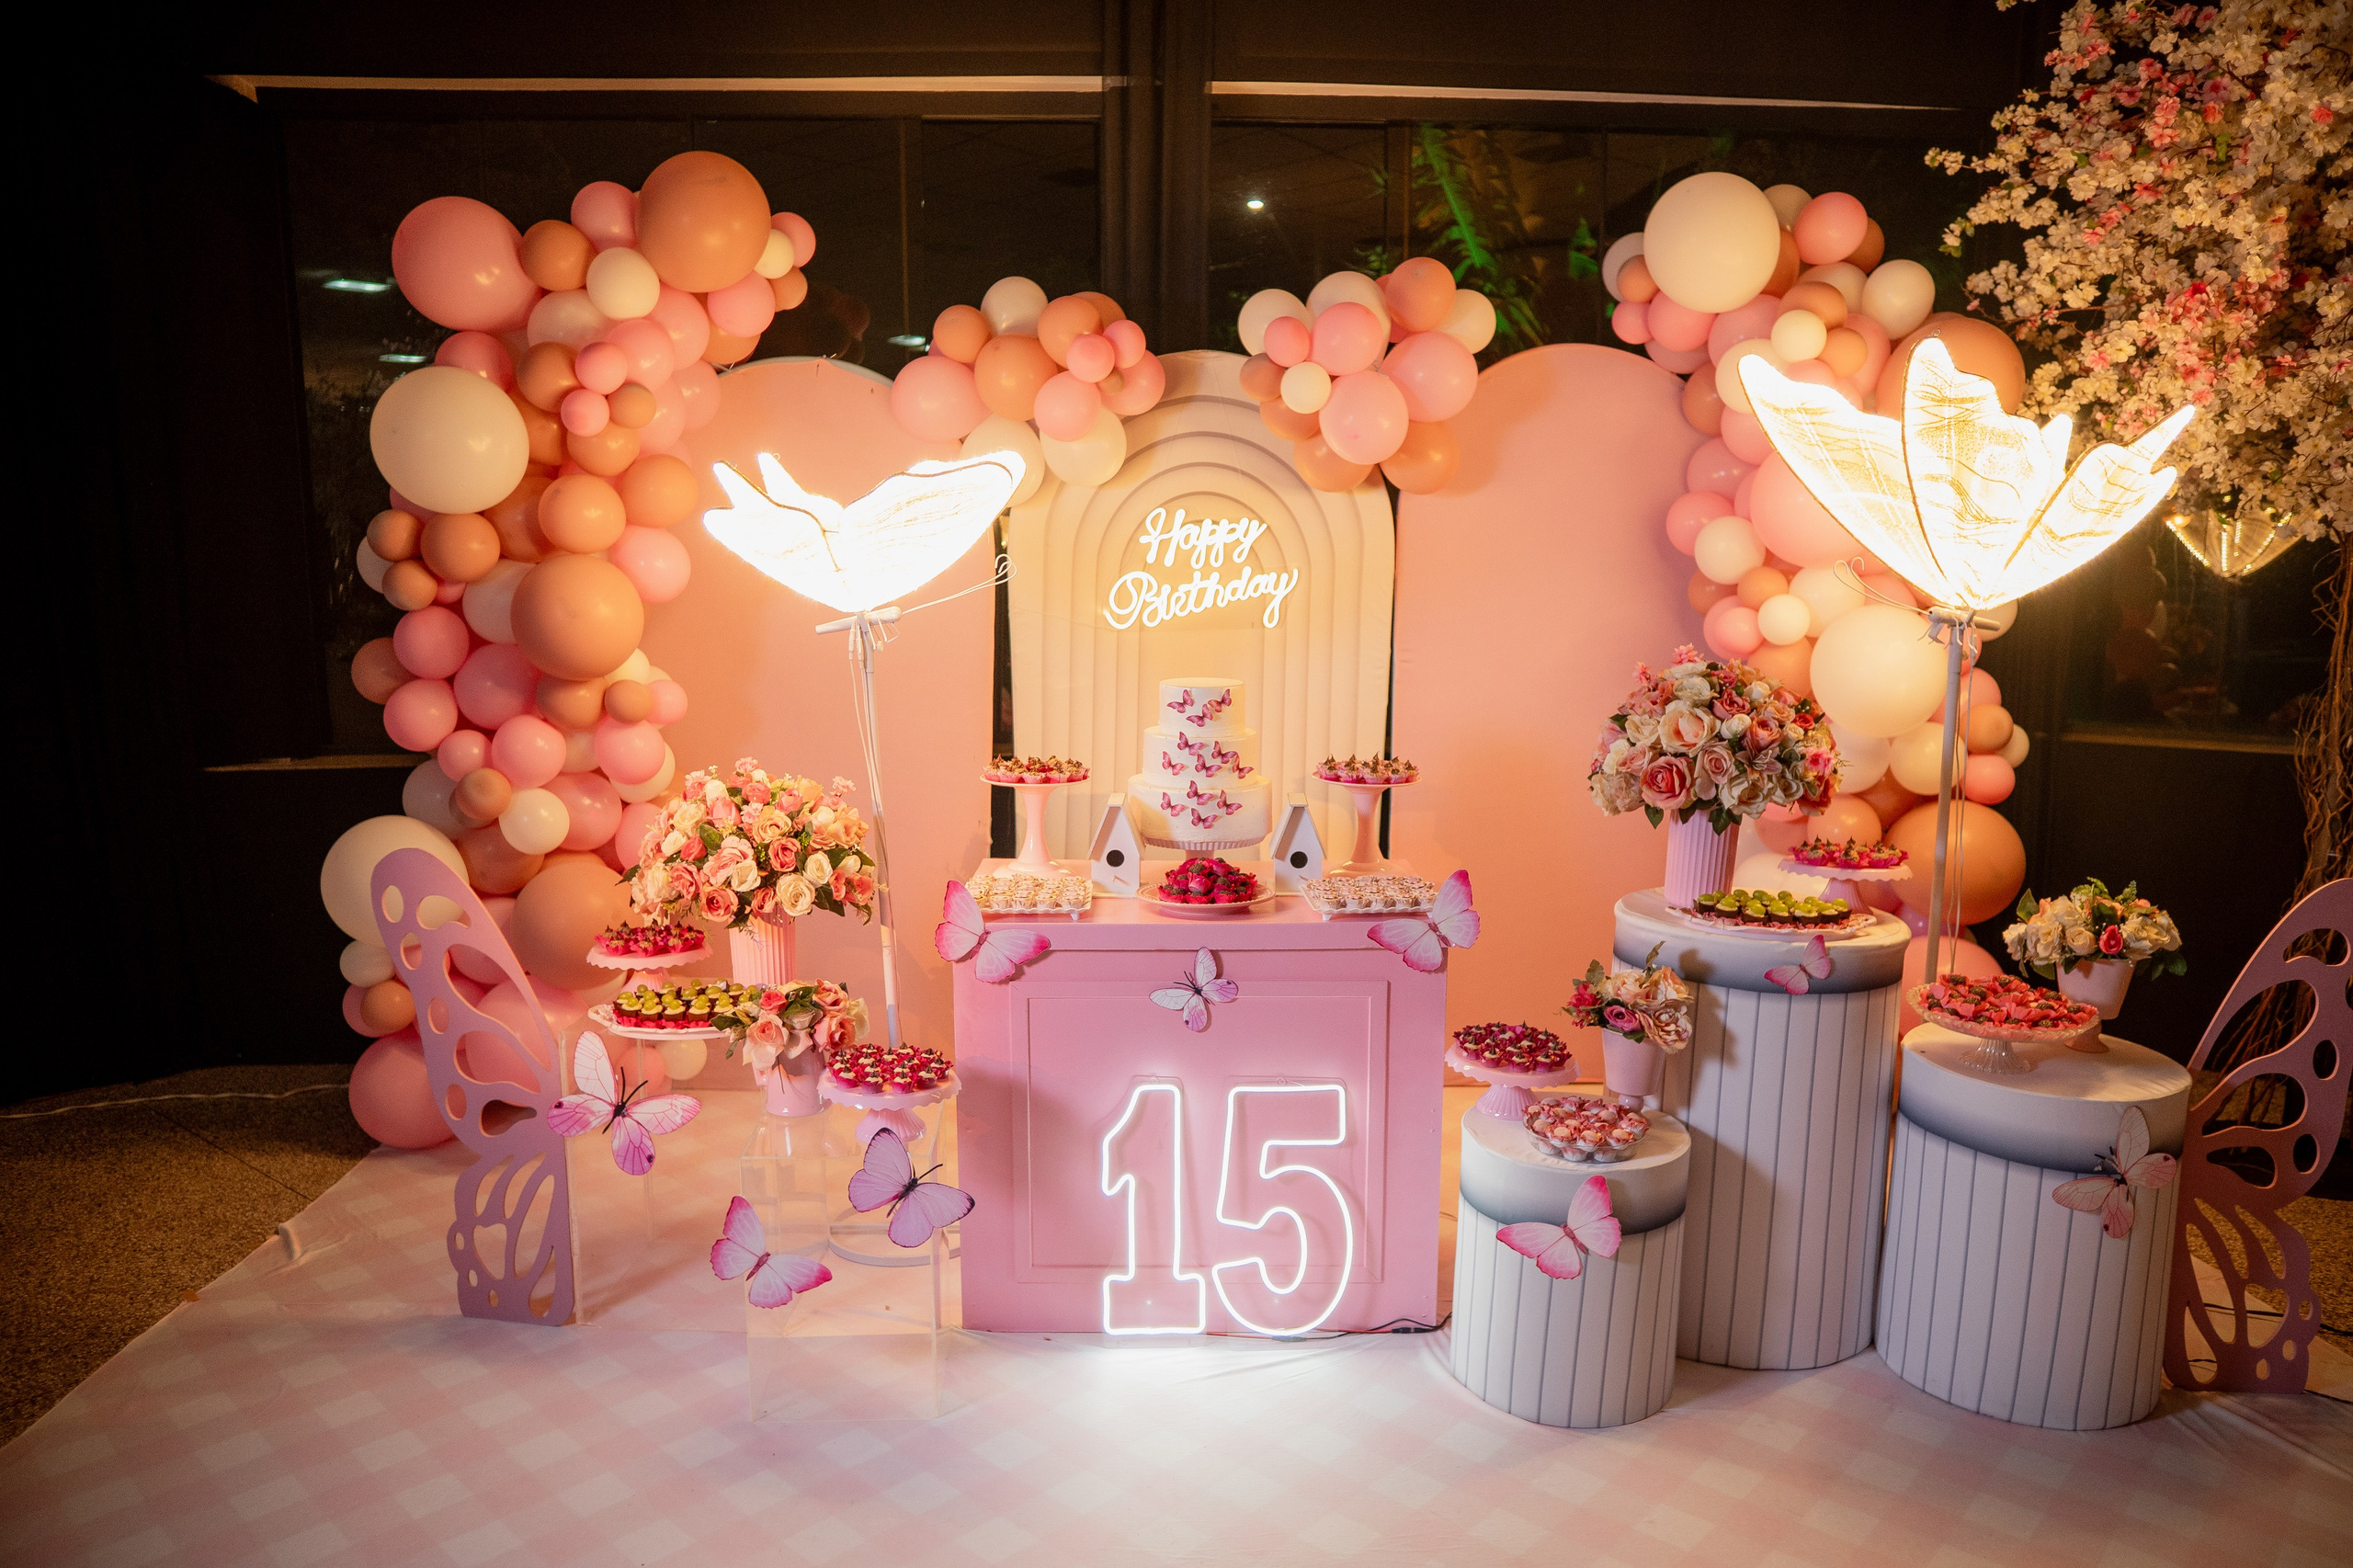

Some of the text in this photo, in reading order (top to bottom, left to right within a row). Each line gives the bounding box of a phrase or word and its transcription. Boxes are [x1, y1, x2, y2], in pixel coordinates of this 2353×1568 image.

[1139, 506, 1268, 570] Happy
[1103, 565, 1299, 630] Birthday
[1100, 1084, 1354, 1337] 15
